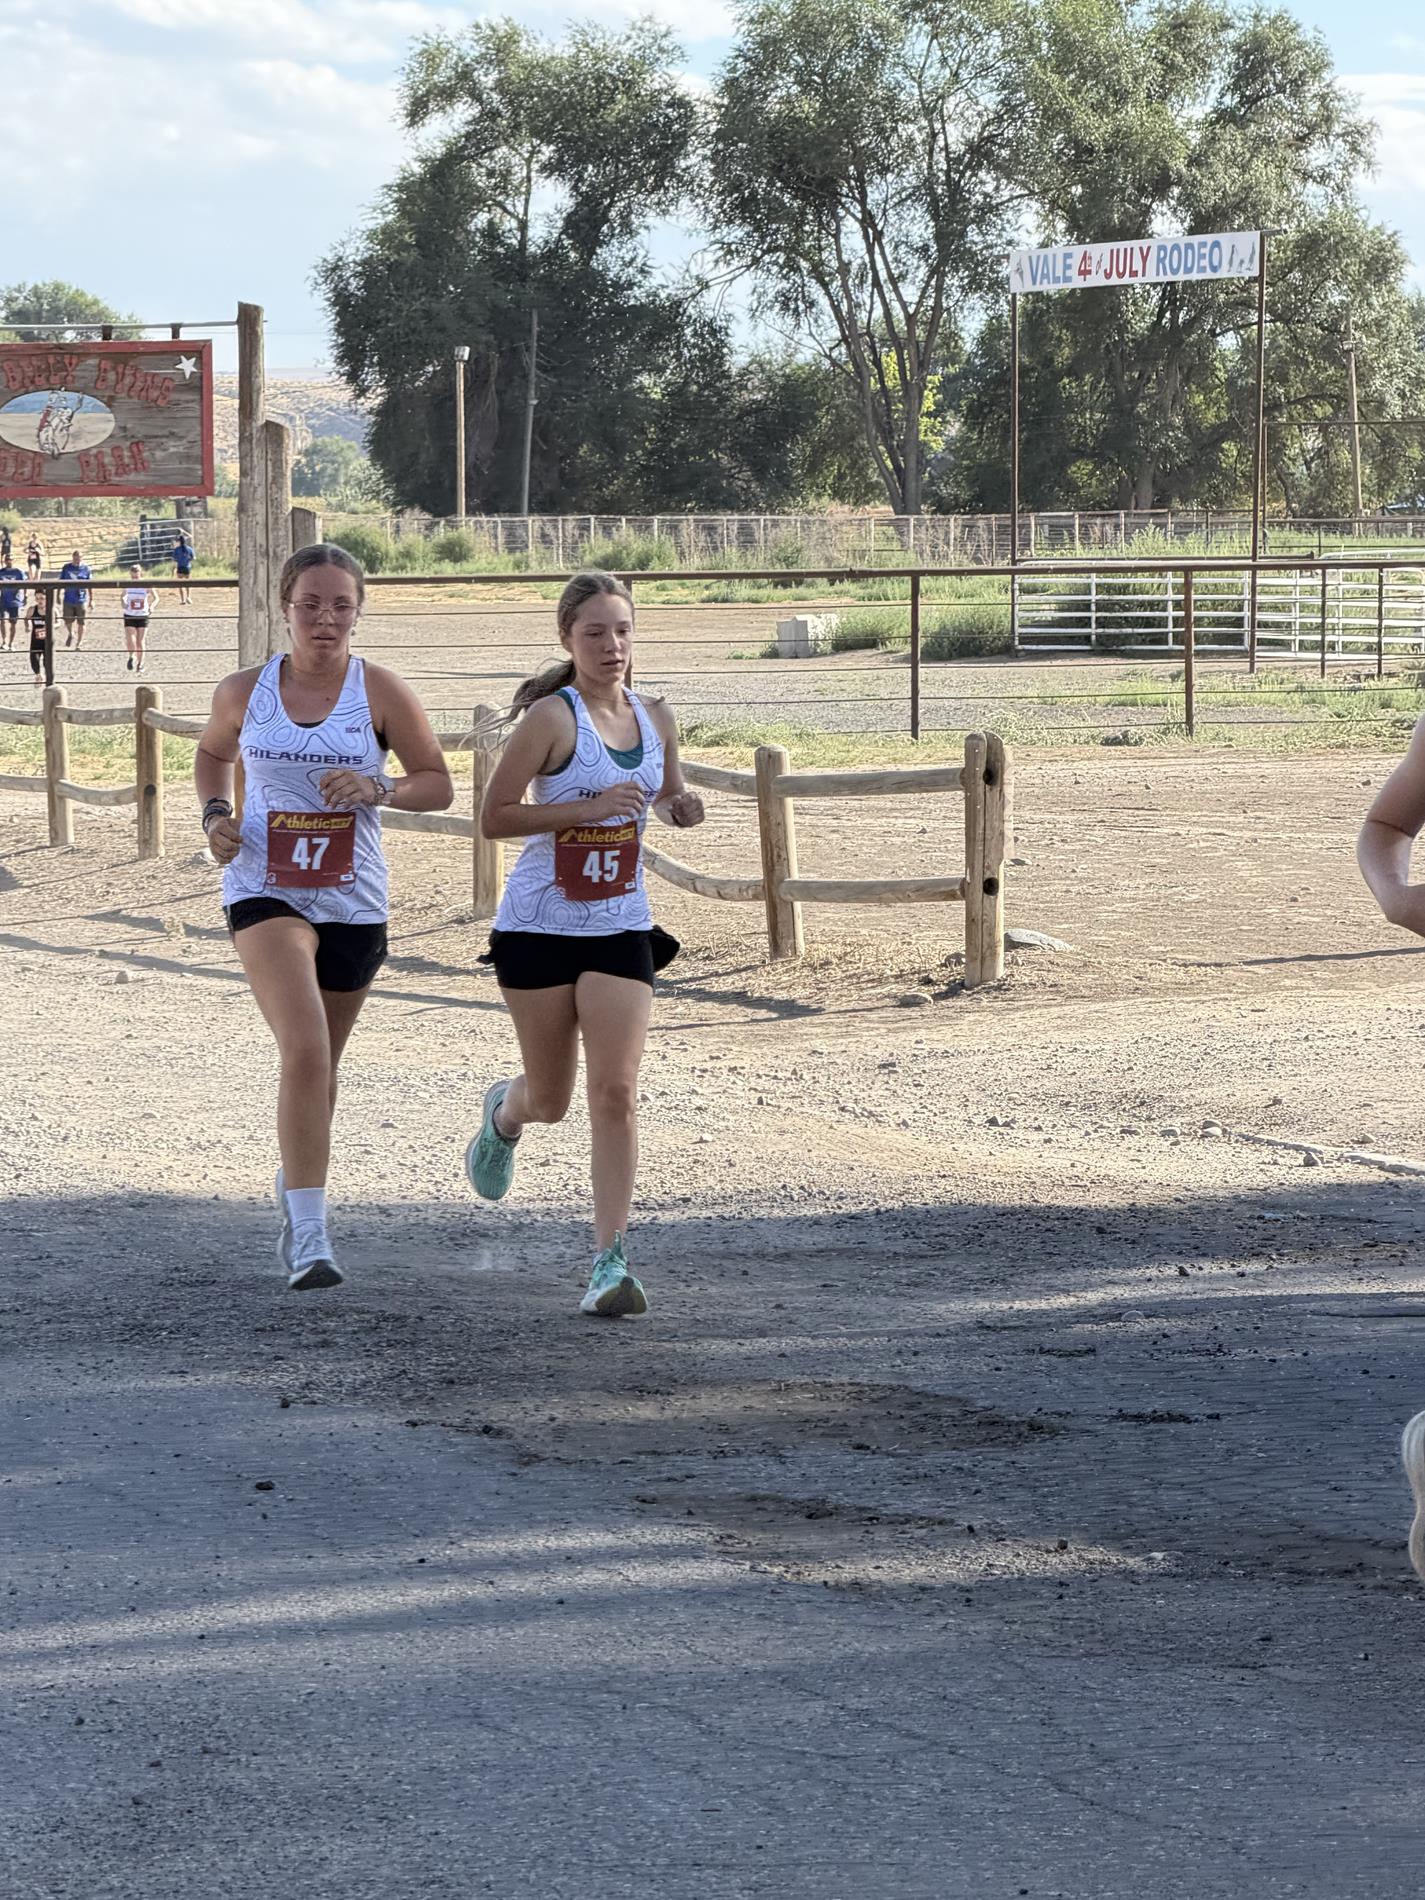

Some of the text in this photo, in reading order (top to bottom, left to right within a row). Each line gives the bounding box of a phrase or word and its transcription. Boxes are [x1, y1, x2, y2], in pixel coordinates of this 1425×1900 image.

[1028, 252, 1073, 286] VALE
[1104, 245, 1152, 280] JULY
[1155, 240, 1223, 277] RODEO
[249, 748, 363, 765] HILANDERS
[291, 837, 331, 870] 47
[582, 850, 620, 883] 45
